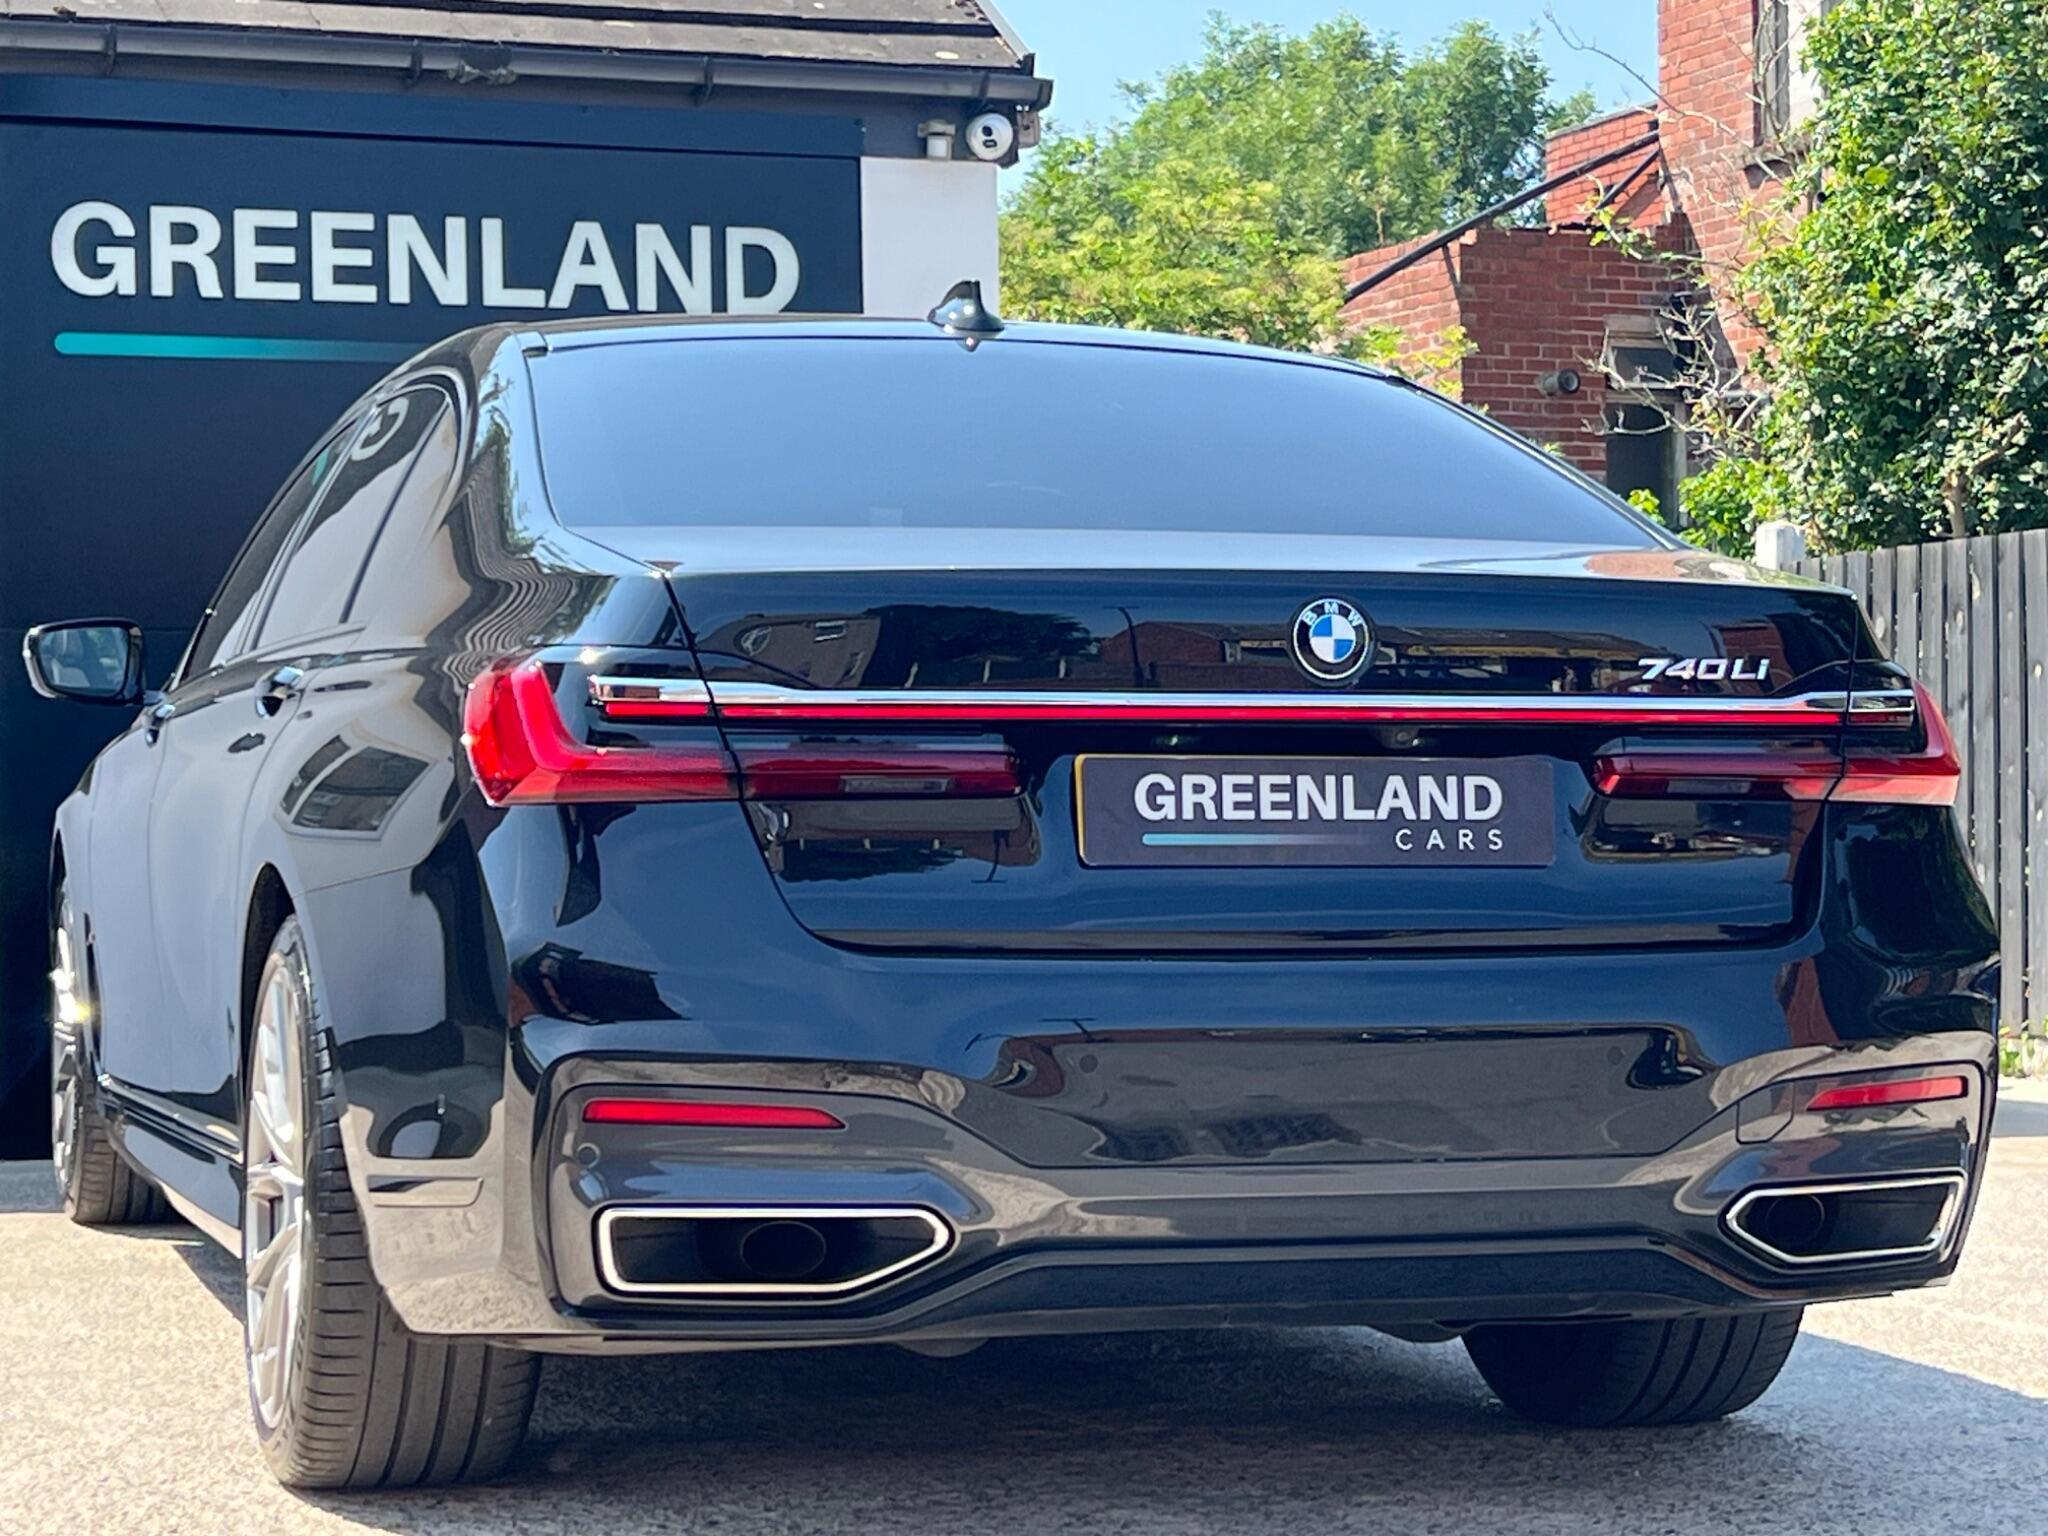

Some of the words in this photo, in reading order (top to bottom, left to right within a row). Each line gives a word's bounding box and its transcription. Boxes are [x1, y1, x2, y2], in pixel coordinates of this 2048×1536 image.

[50, 200, 800, 314] GREENLAND
[1300, 601, 1362, 627] BMW
[1134, 773, 1503, 821] GREENLAND
[1395, 828, 1503, 851] CARS
